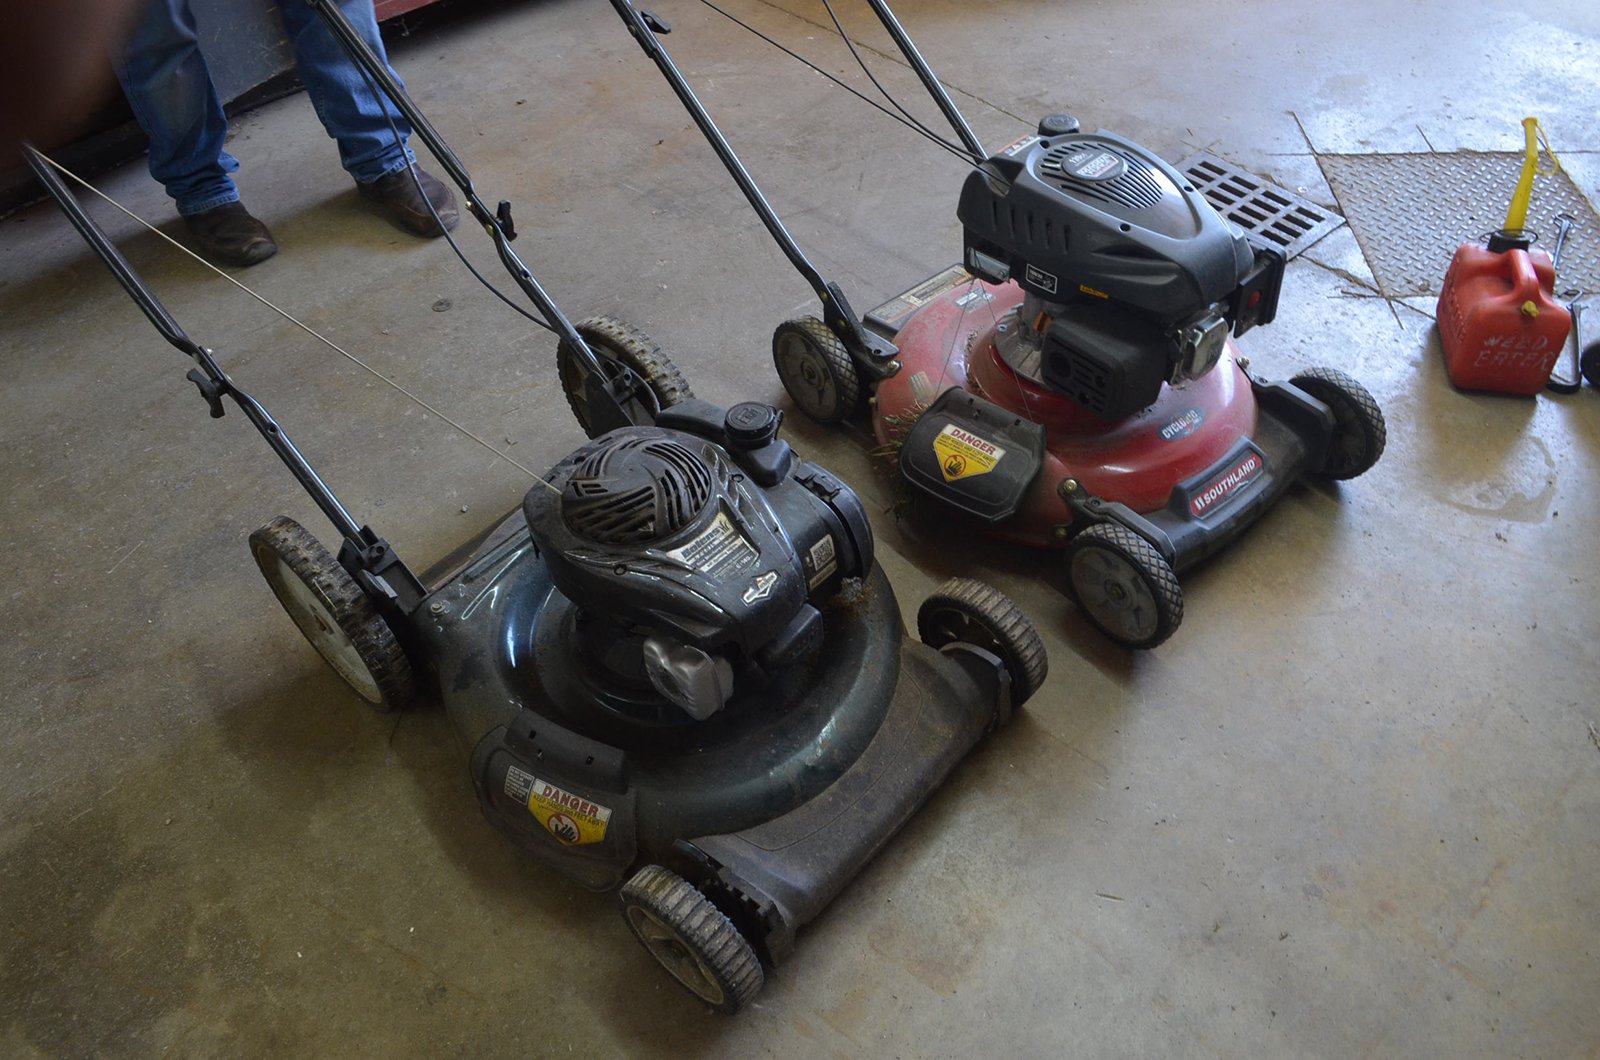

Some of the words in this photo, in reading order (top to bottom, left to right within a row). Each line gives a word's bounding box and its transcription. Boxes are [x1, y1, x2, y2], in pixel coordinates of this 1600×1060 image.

[1483, 335, 1548, 350] WEED
[1474, 350, 1556, 371] EATER
[951, 428, 996, 455] DANGER
[1203, 459, 1256, 504] SOUTHLAND
[680, 527, 719, 557] Bolens
[543, 785, 599, 818] DANGER
